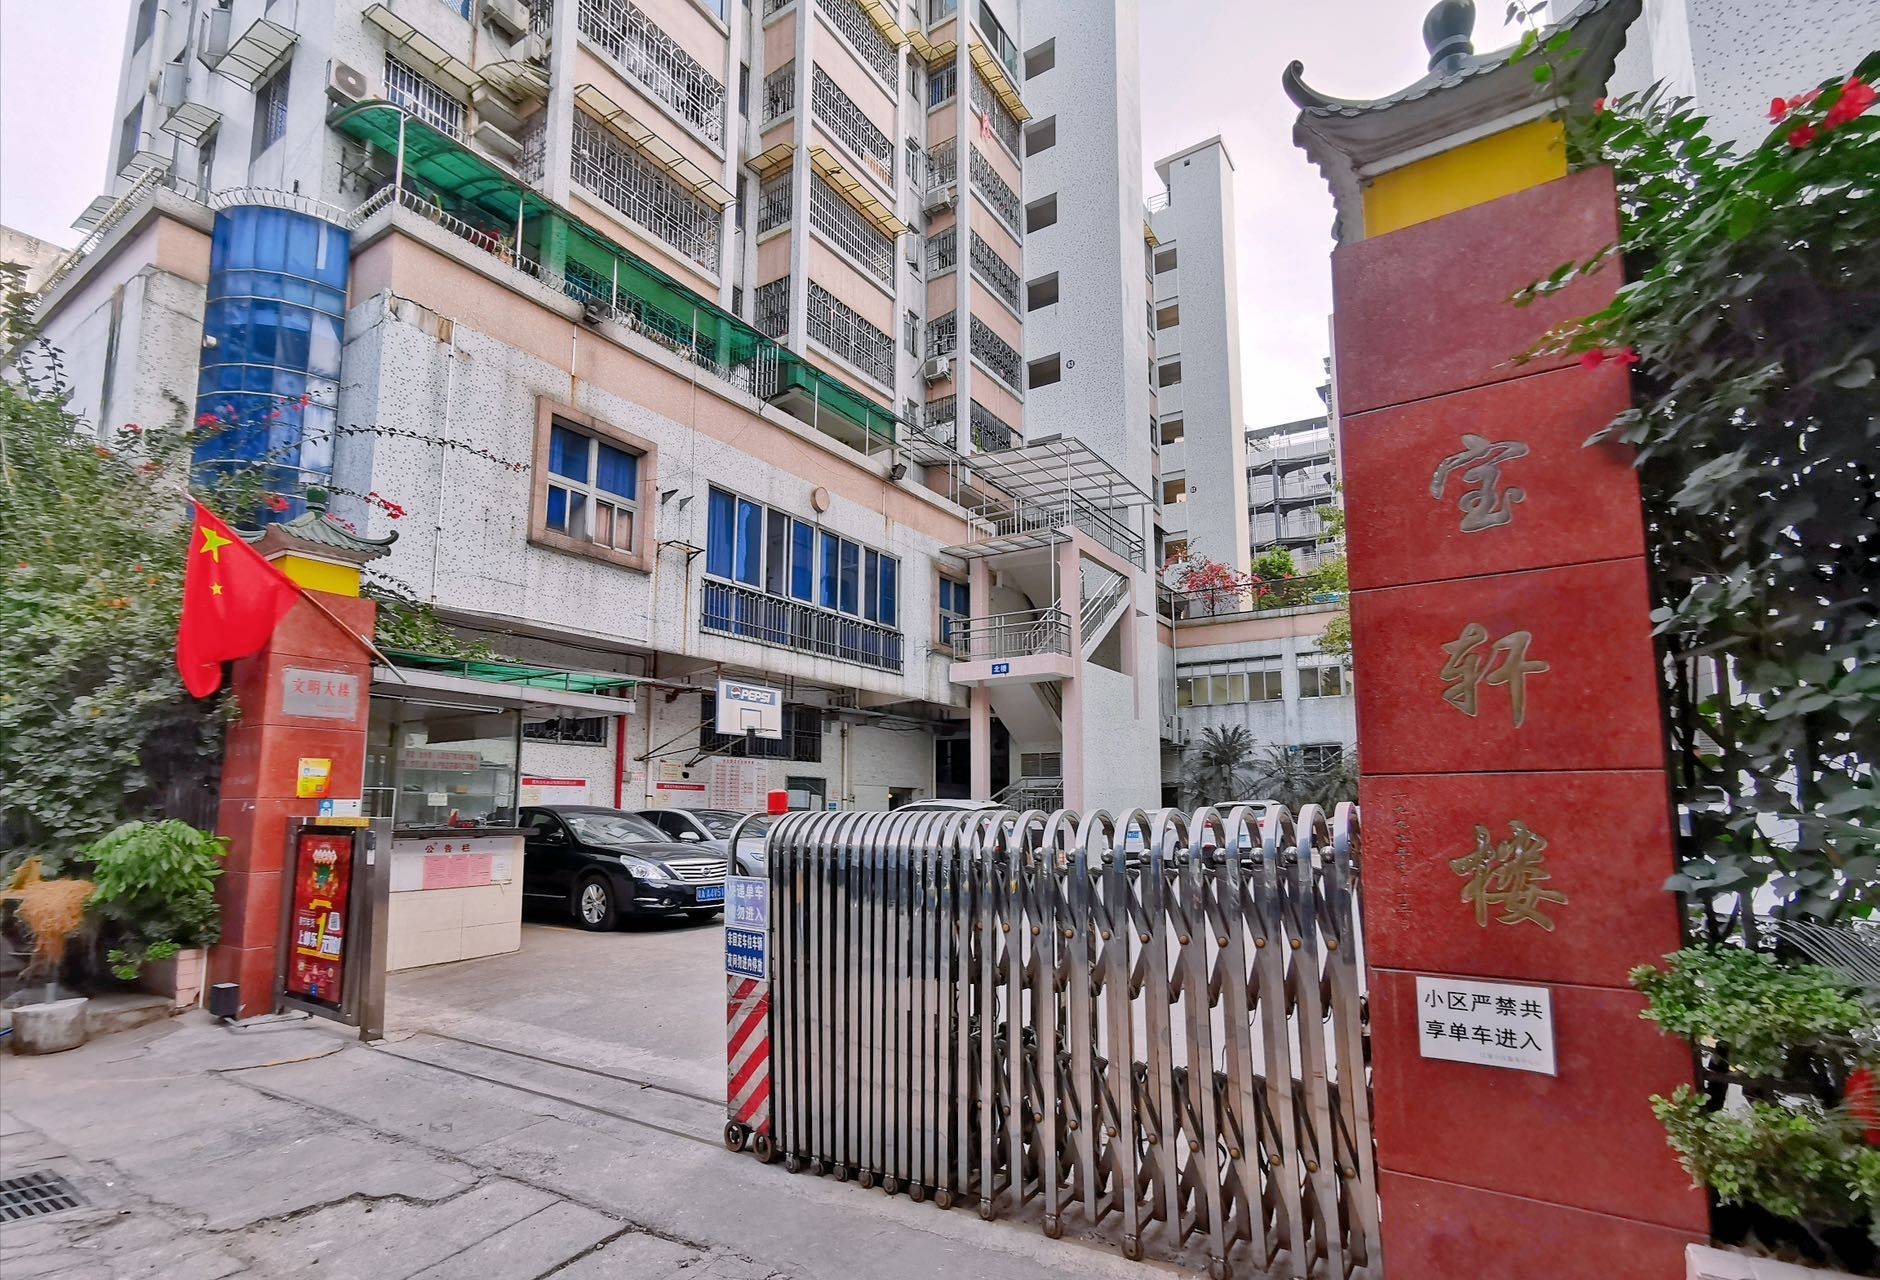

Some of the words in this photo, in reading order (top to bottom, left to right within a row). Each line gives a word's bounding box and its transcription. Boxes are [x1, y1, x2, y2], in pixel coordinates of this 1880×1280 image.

[292, 678, 352, 697] 文明大楼
[1430, 433, 1569, 932] 宝轩楼
[741, 688, 771, 704] PEPSI
[425, 843, 471, 853] 公告栏
[728, 905, 764, 922] 勿进入
[1425, 989, 1543, 1020] 小区严禁共
[1425, 1019, 1543, 1051] 享单车进入
